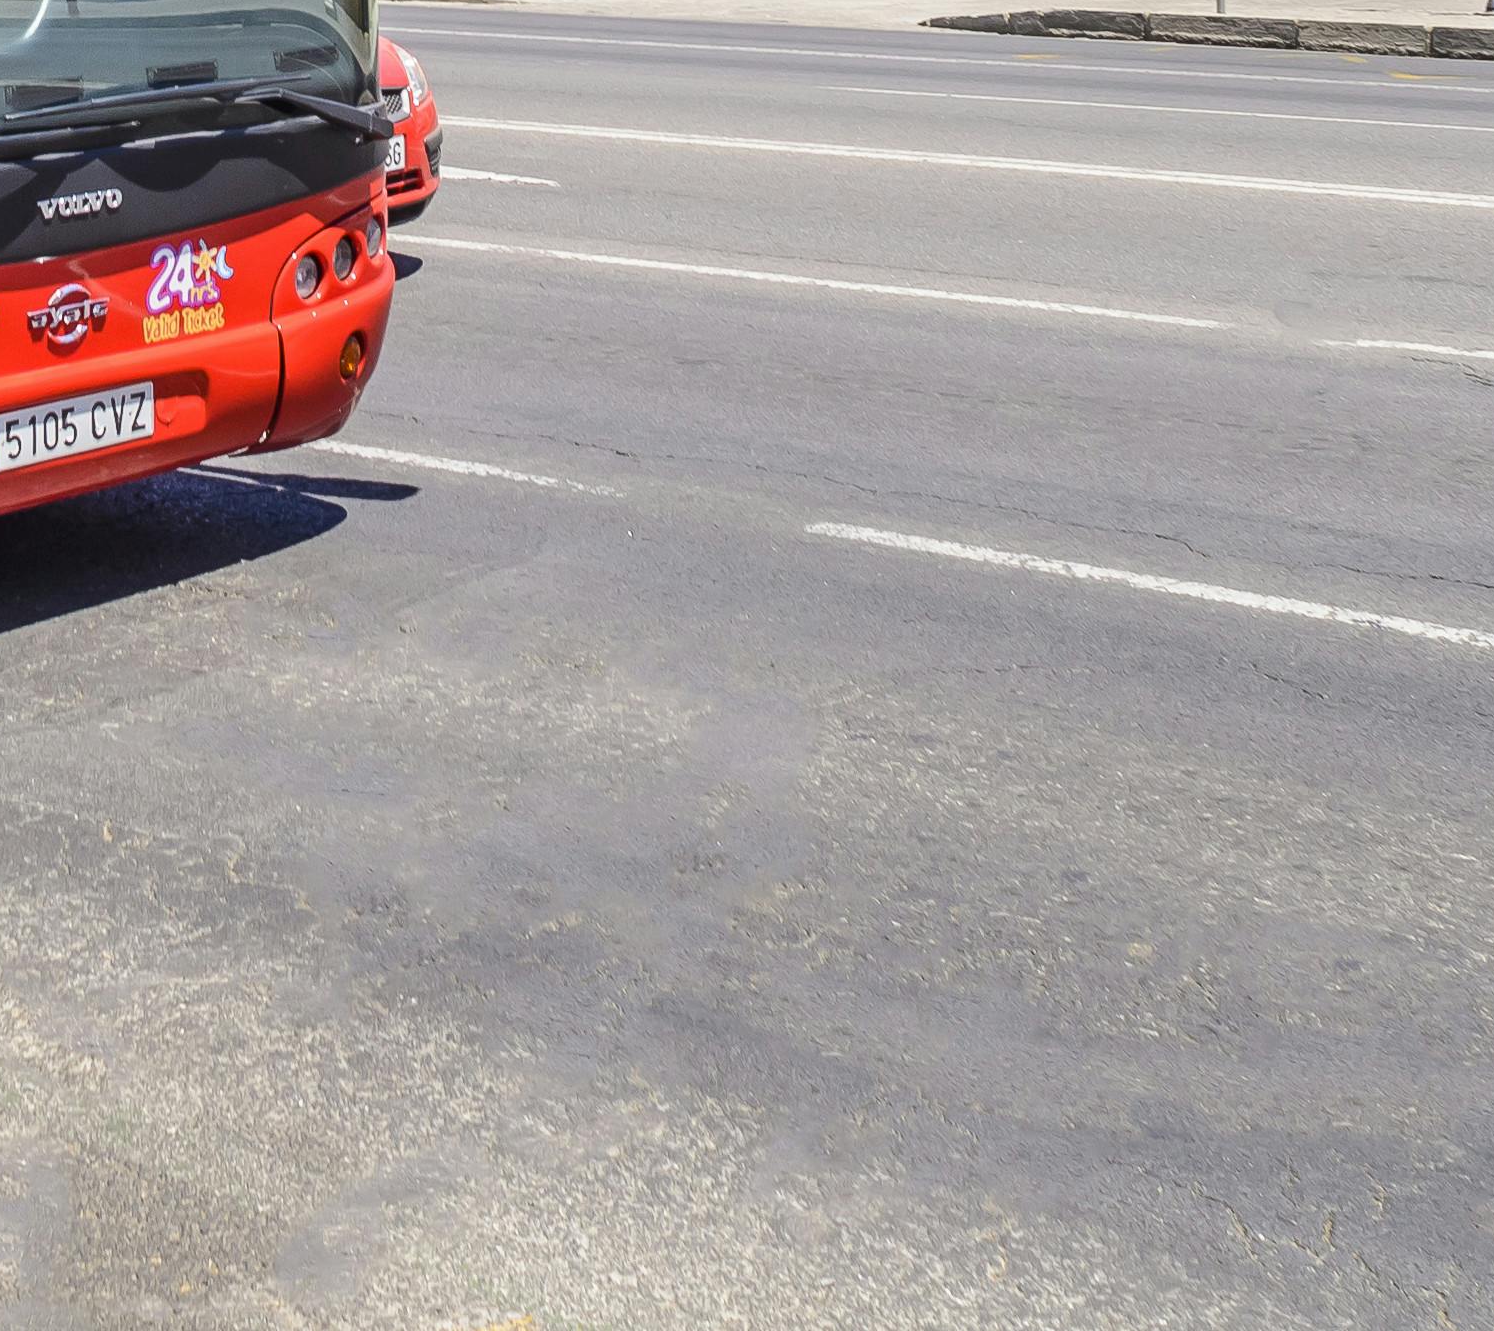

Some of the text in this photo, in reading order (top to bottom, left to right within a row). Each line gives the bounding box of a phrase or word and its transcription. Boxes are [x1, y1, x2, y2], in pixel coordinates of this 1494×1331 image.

[37, 187, 124, 221] VOLVO
[148, 243, 195, 313] 24
[142, 302, 225, 345] Valid Ticket
[4, 406, 79, 460] 5105
[91, 391, 147, 440] CVZ
